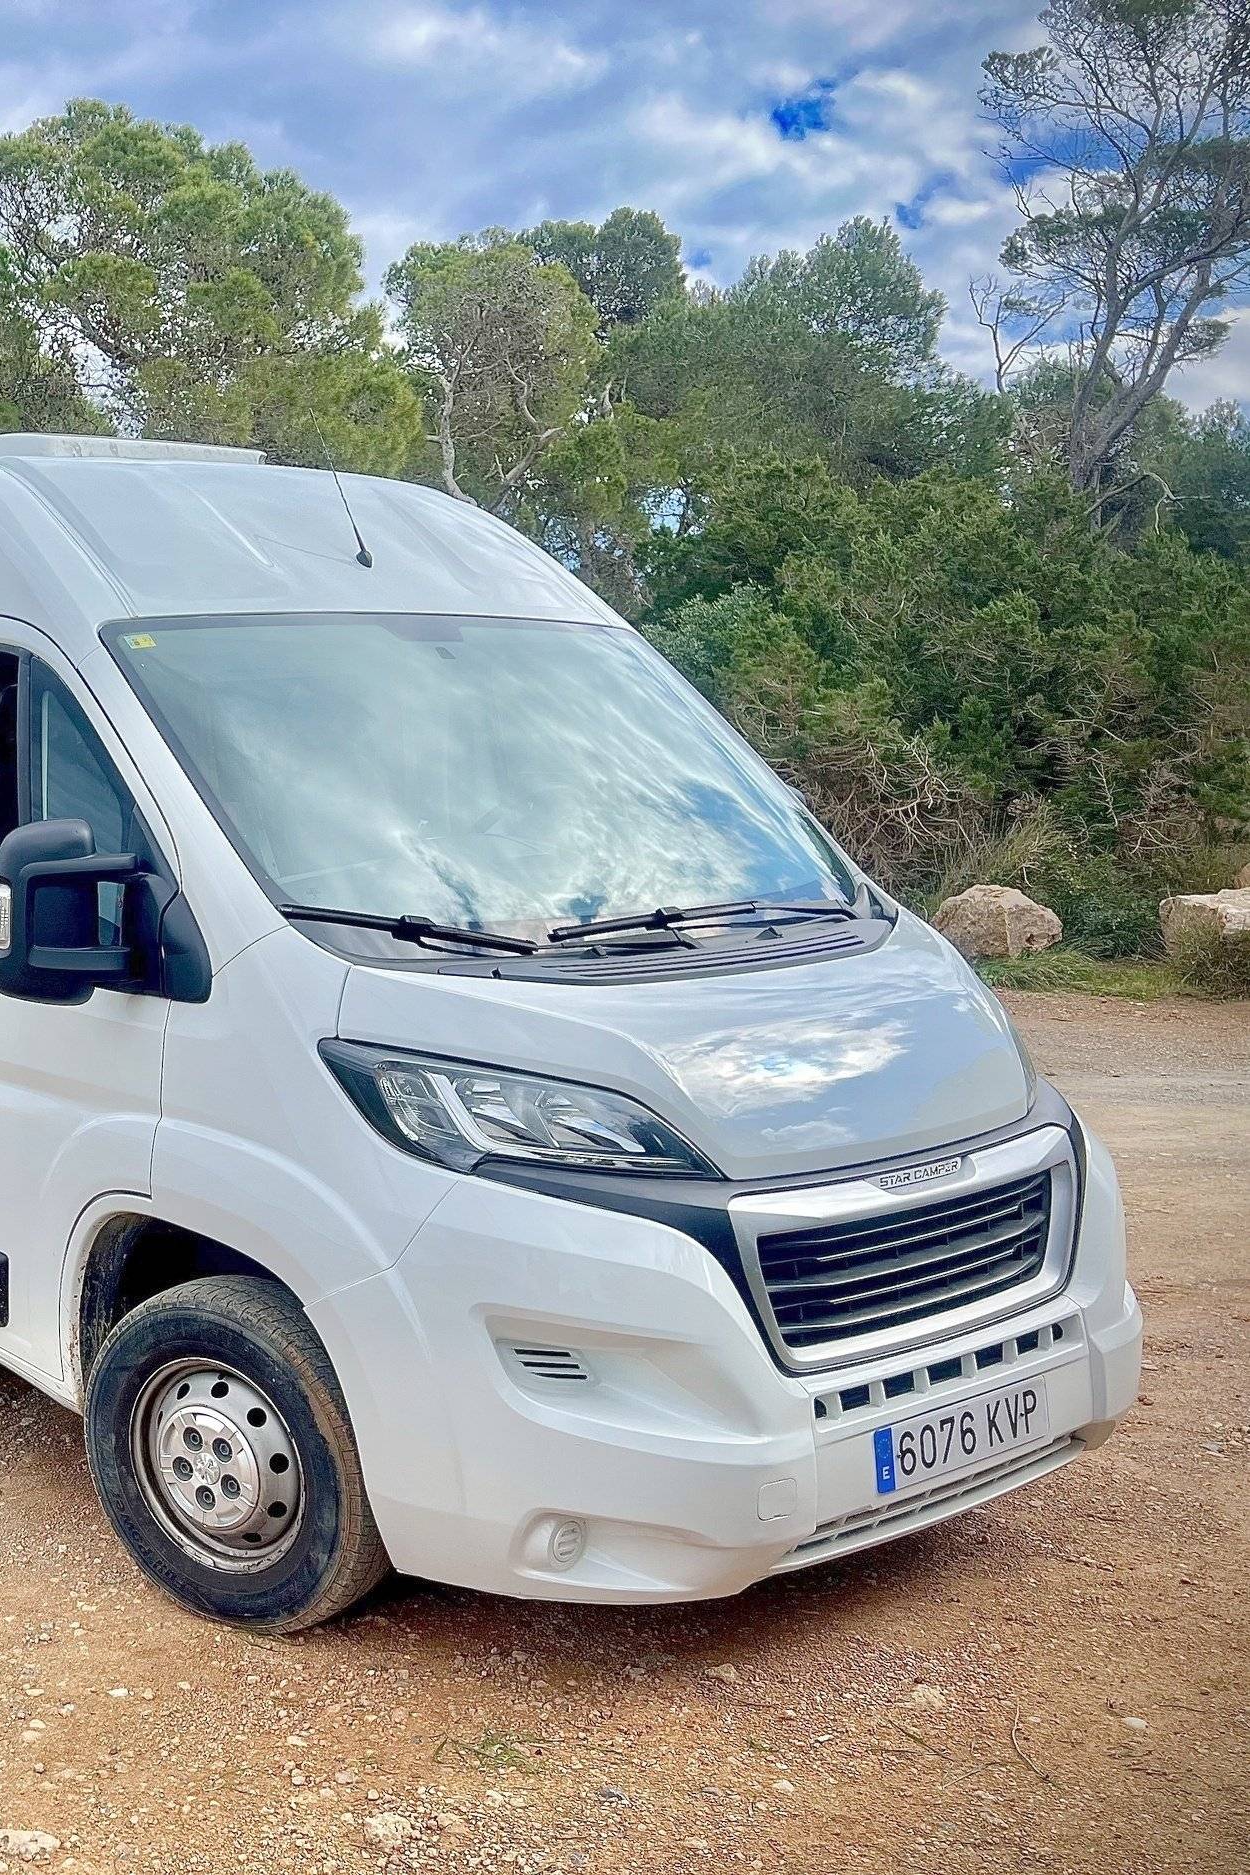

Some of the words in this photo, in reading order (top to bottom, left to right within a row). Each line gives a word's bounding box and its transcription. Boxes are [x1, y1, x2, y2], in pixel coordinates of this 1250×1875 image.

[879, 1172, 911, 1188] STAR
[914, 1160, 959, 1180] CAMPER
[882, 1465, 890, 1480] E
[899, 1411, 977, 1476] 6076
[986, 1389, 1037, 1447] KVP
